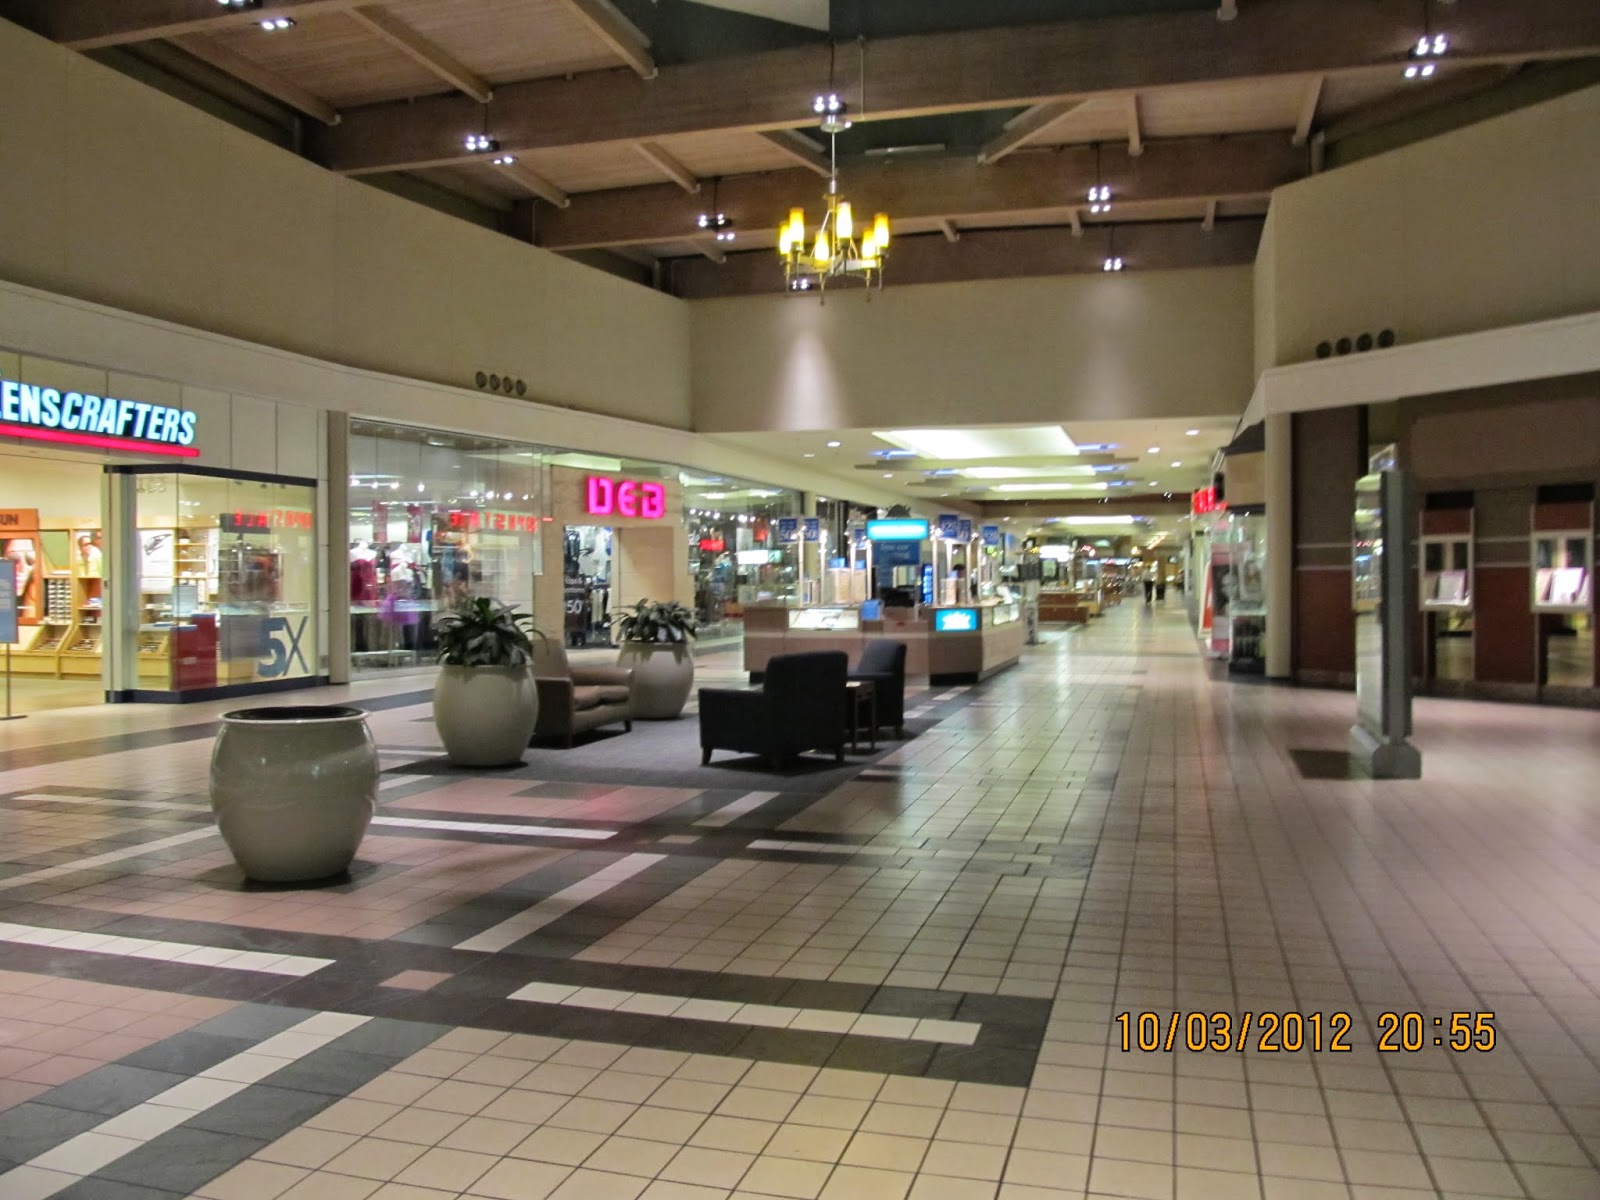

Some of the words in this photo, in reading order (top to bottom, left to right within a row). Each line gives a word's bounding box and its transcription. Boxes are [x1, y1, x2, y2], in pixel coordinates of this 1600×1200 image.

[0, 379, 197, 445] ENSCRAFTERS
[588, 476, 665, 519] DEB
[257, 615, 309, 678] 5X
